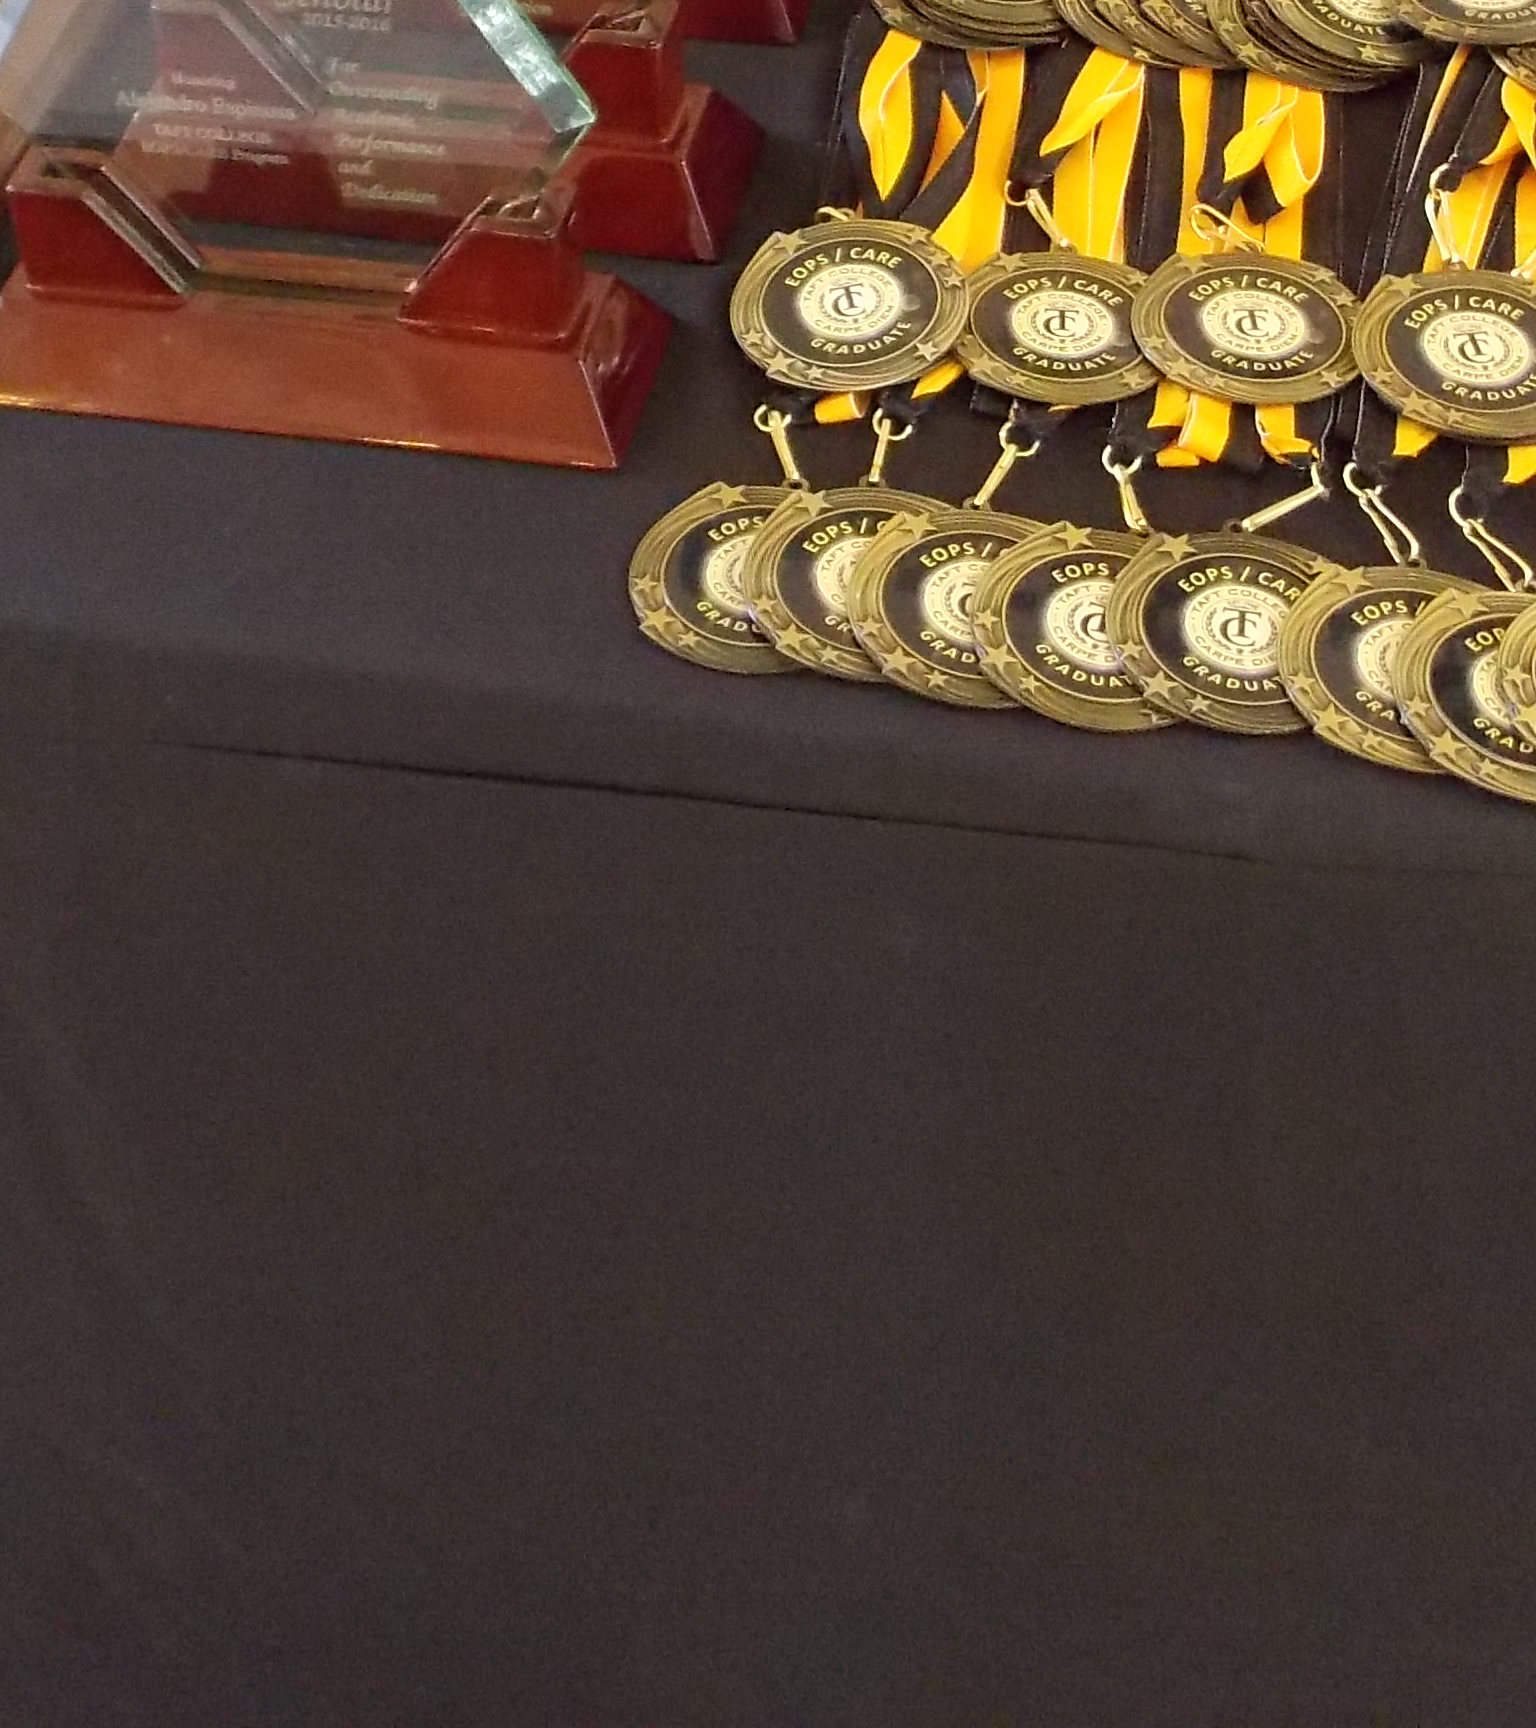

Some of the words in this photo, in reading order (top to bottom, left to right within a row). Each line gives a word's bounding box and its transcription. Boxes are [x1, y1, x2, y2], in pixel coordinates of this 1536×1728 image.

[784, 253, 831, 288] EOPS
[849, 247, 902, 269] CARE
[1002, 276, 1052, 300] EOPS
[1073, 279, 1123, 307] CARE
[1188, 276, 1234, 301] EOPS
[1256, 277, 1309, 303] CARE
[1404, 298, 1448, 329] EOPS
[1468, 296, 1524, 320] CARE
[810, 321, 911, 355] GRADUATE
[1012, 347, 1116, 372] GRADUATE
[1211, 350, 1314, 371] GRADUATE
[708, 516, 764, 542] EOPS
[802, 521, 853, 553] EOPS
[919, 542, 975, 567] EOPS
[1051, 563, 1109, 583] EOPS
[1178, 566, 1233, 592] EOPS
[1258, 572, 1300, 601] CAR
[696, 602, 761, 633] GRADU
[1350, 600, 1408, 626] EOPS
[920, 632, 977, 663] GRAD
[1465, 627, 1504, 652] EOP
[1035, 644, 1132, 688] GRADUAT
[1183, 656, 1282, 692] GRADUAT
[1473, 717, 1534, 753] GRAD
